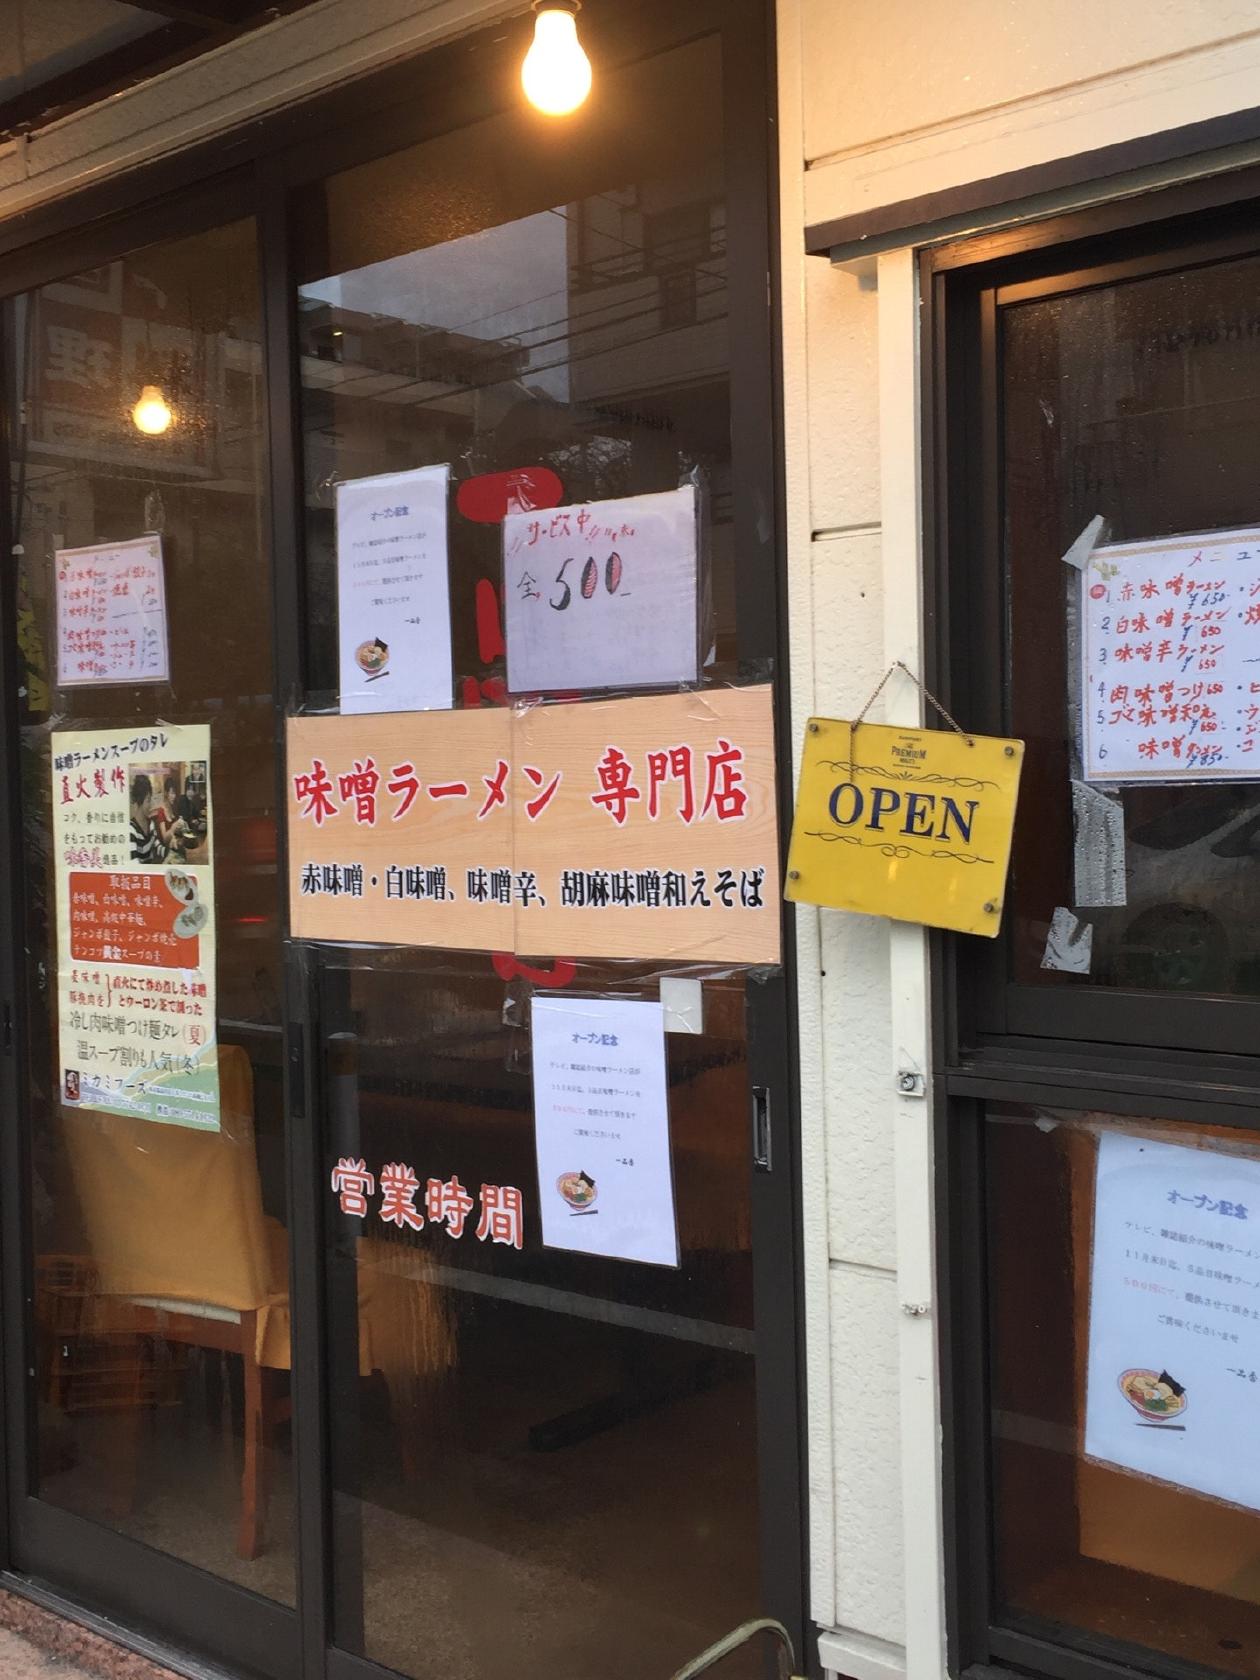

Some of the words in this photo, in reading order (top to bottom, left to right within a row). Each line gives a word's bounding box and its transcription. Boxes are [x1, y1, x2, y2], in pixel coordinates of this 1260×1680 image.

[1115, 608, 1233, 634] 白味噌ラーメン
[54, 732, 169, 772] 味噌ラーメンスープのタレ
[891, 745, 927, 760] PREMIUM
[294, 754, 562, 827] 味噌ラーメン
[592, 737, 751, 827] 専門店
[829, 783, 980, 845] OPEN
[331, 1157, 523, 1249] 営業時間
[1168, 1189, 1249, 1220] オープン記念
